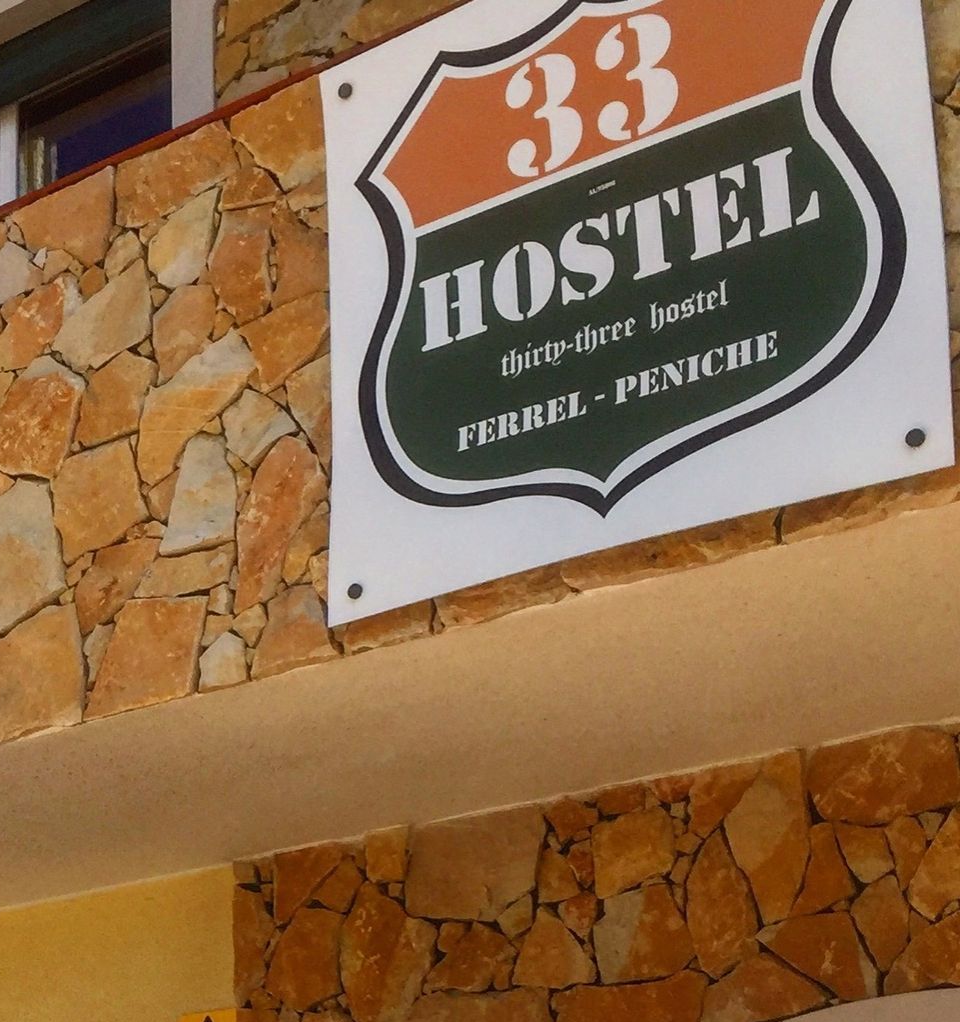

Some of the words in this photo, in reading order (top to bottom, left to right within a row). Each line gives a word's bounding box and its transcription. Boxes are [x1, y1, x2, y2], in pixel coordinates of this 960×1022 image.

[505, 13, 679, 178] 33
[419, 147, 821, 353] HOSTEL
[457, 391, 587, 452] FERREL
[614, 331, 778, 406] PENICHE
[500, 317, 637, 378] thirty-three
[649, 280, 729, 333] hostel
